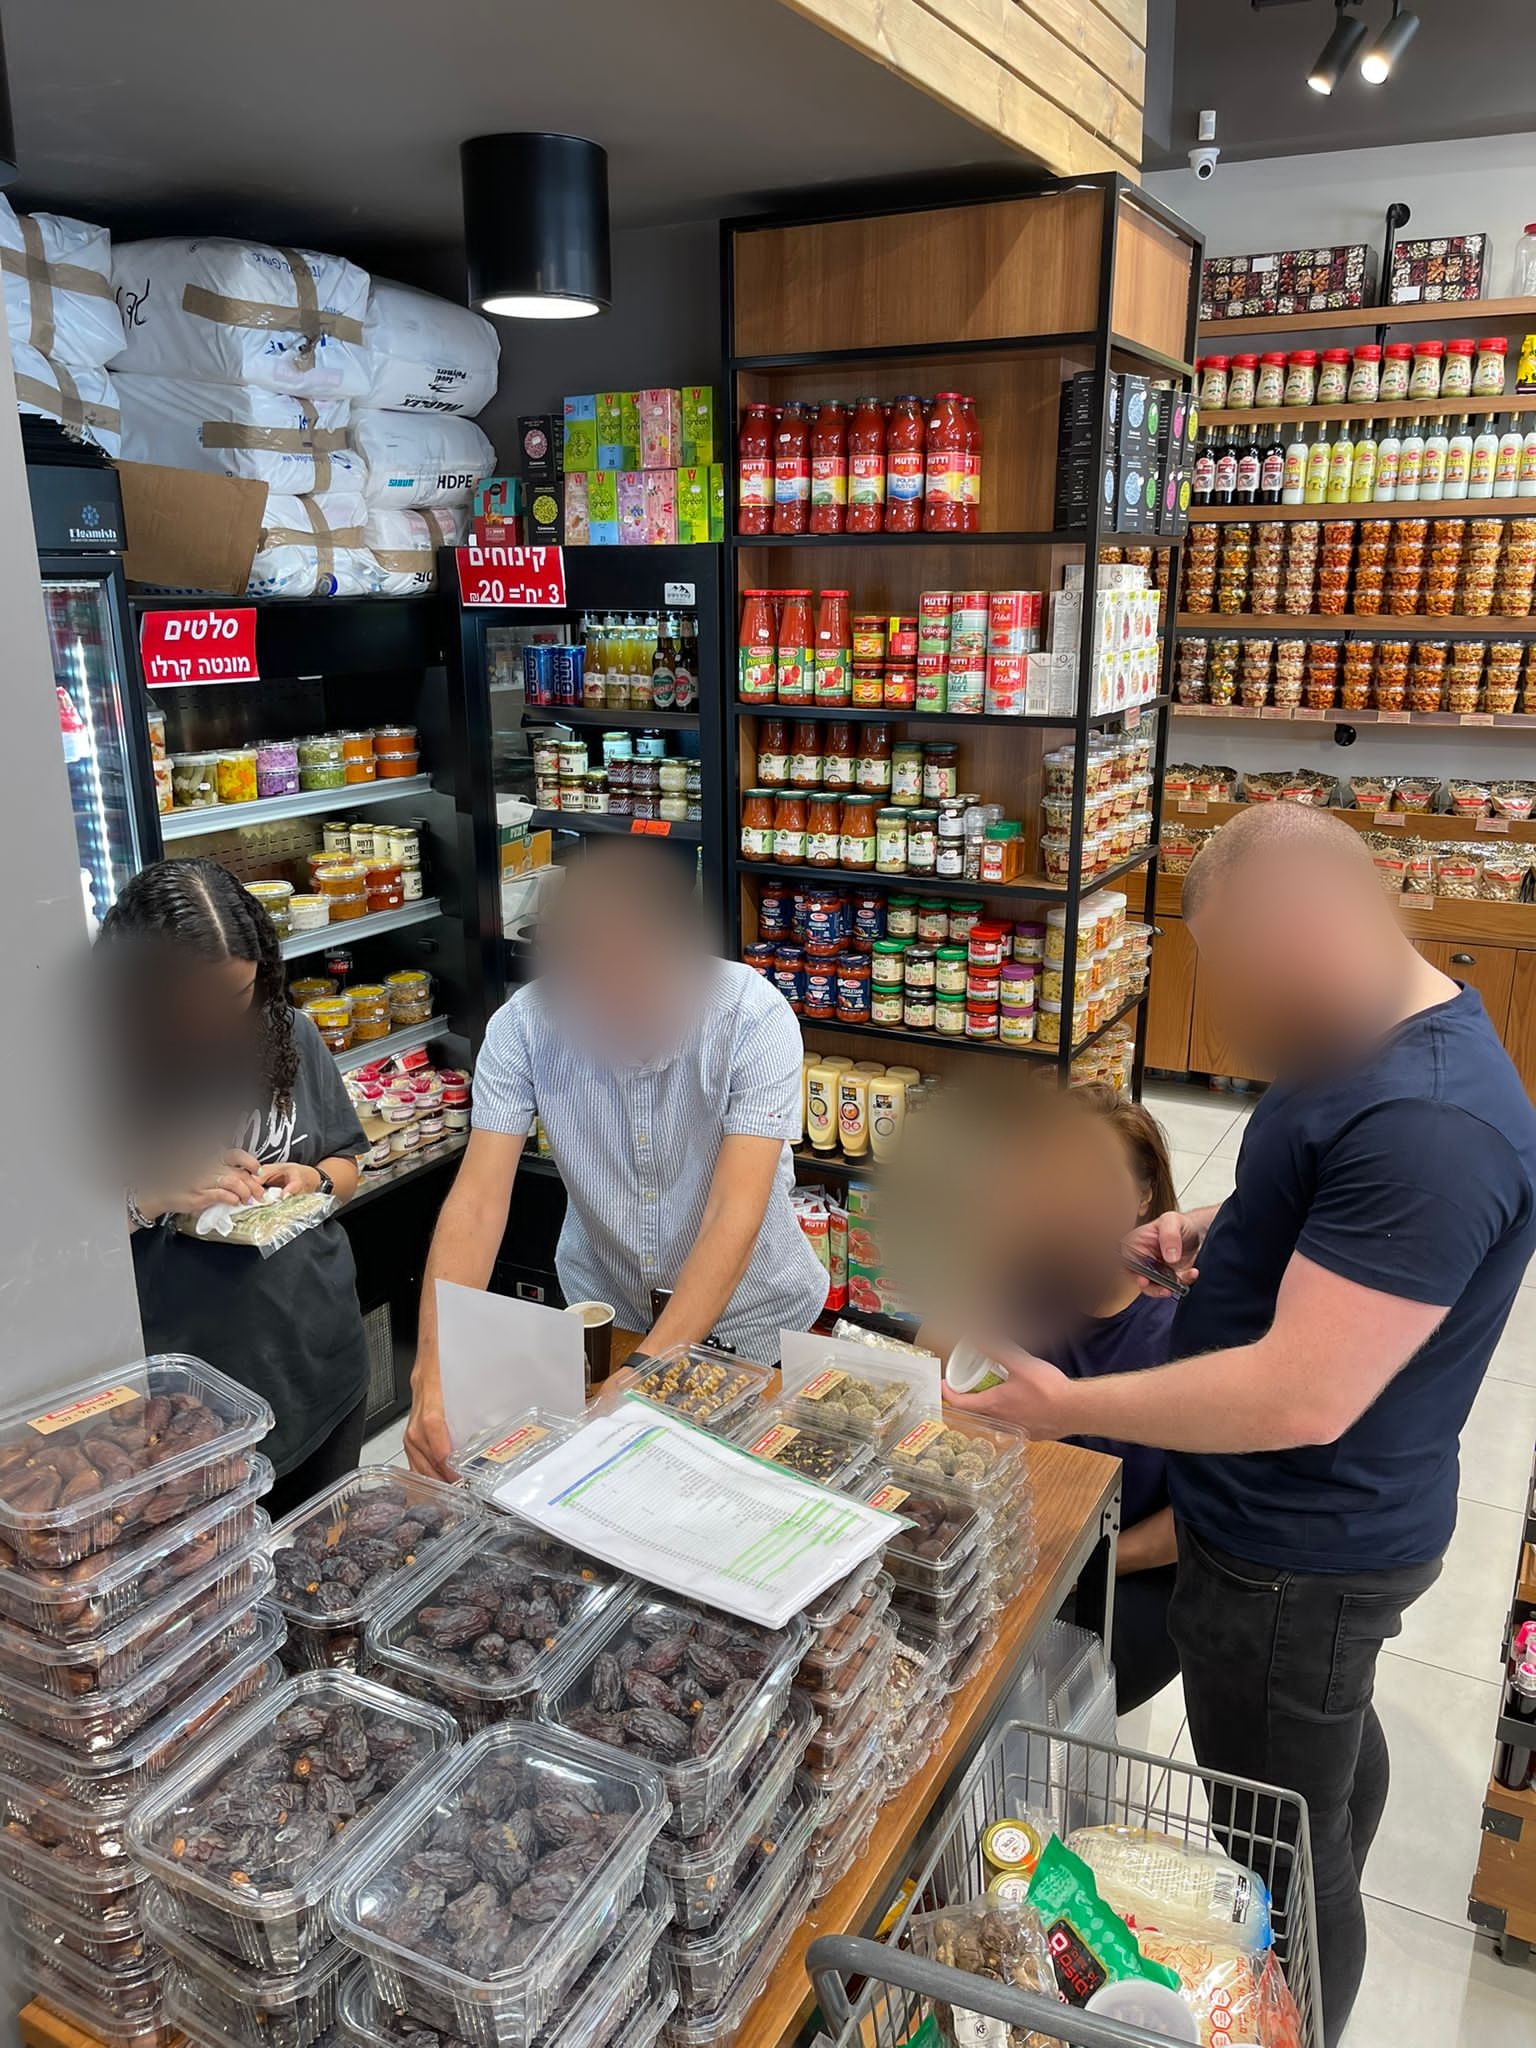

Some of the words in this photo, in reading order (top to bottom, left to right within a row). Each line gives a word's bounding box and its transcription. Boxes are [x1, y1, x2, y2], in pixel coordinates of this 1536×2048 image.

[895, 457, 919, 465] MUTTI
[437, 474, 473, 489] HDPE
[468, 547, 547, 573] קינוחים
[548, 583, 560, 604] 3
[923, 596, 950, 606] MUTTI
[164, 611, 239, 641] סלטים
[151, 654, 192, 681] קרלו
[197, 655, 251, 675] מונטה
[993, 658, 1019, 667] MUTTI
[804, 1221, 827, 1229] MUTTI
